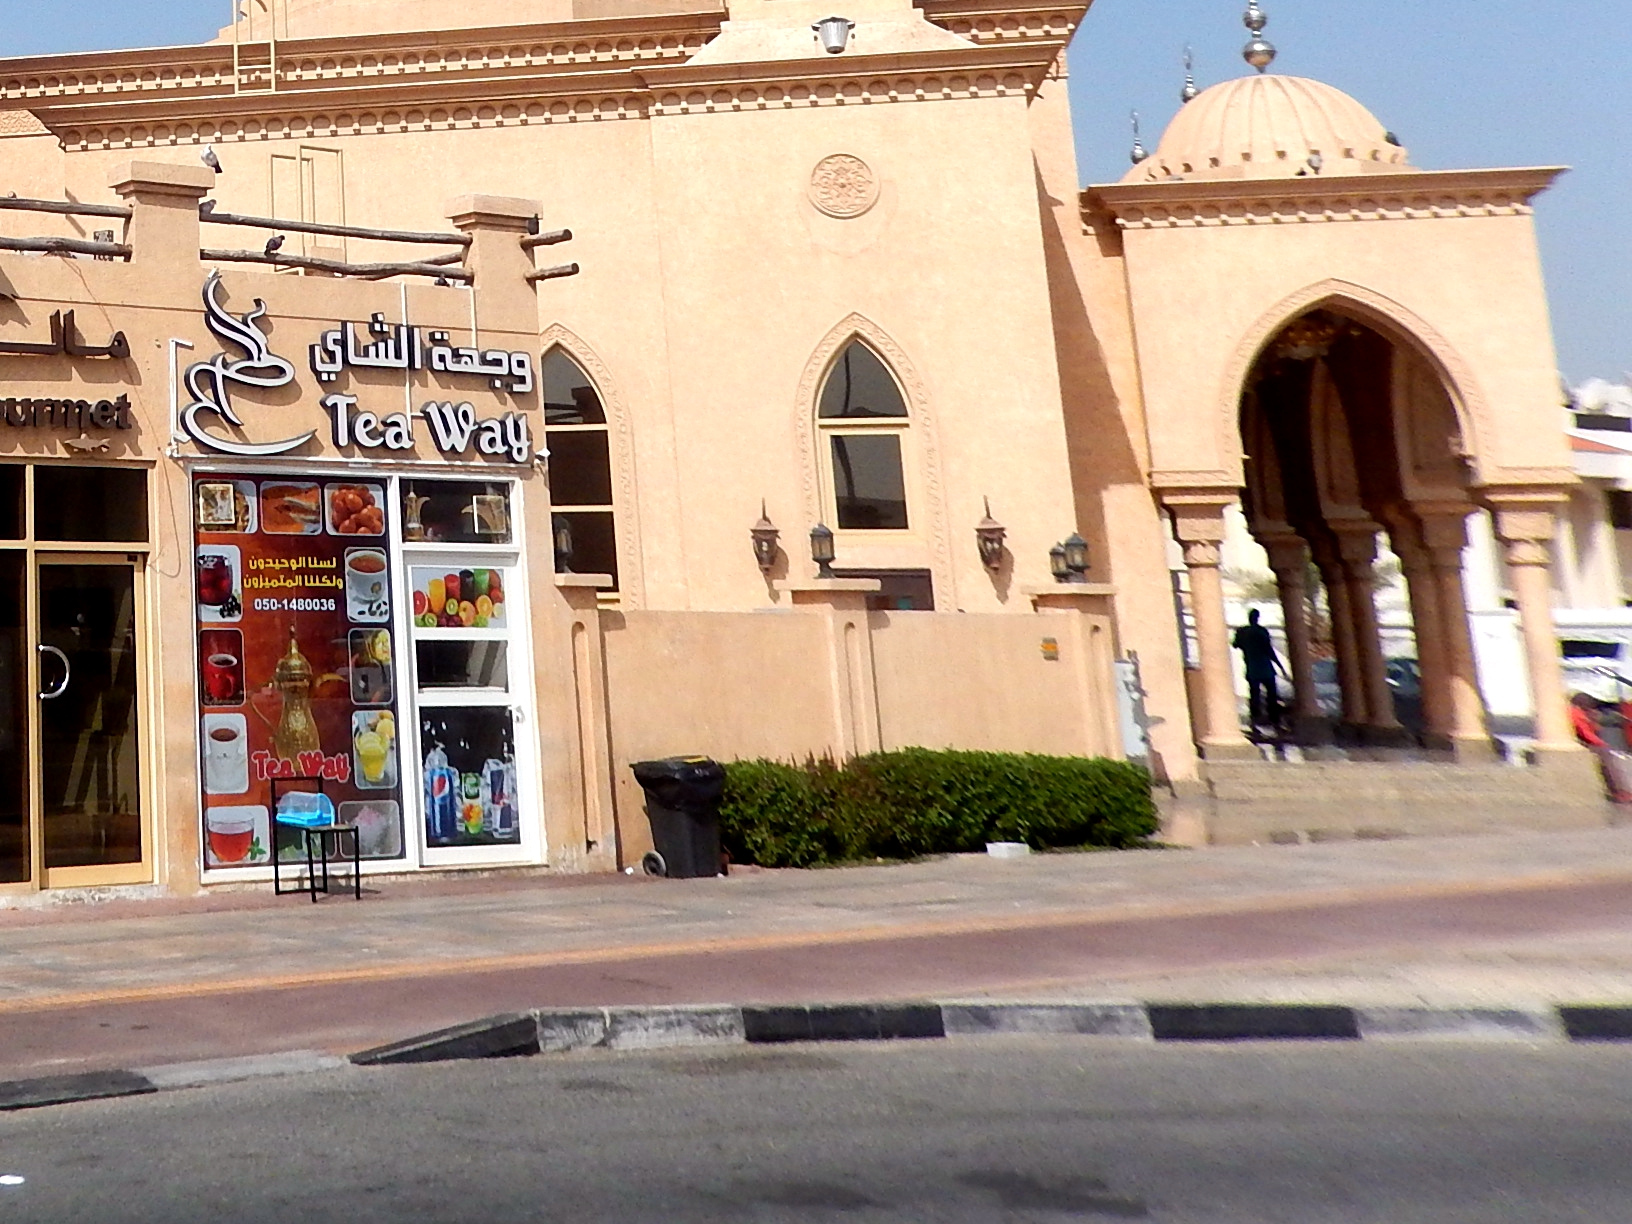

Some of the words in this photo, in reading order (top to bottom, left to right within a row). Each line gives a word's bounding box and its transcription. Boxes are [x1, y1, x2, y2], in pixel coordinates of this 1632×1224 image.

[309, 312, 422, 381] الشاي
[427, 330, 532, 393] وجهة
[320, 392, 414, 450] Tea
[421, 400, 532, 463] Way
[248, 556, 307, 570] الوحيدون
[308, 556, 337, 569] لسنا
[243, 574, 303, 589] المتميزون
[304, 575, 344, 590] ولكننا
[254, 598, 336, 611] 050-1480036
[251, 749, 297, 780] Tea
[297, 750, 351, 783] Way
